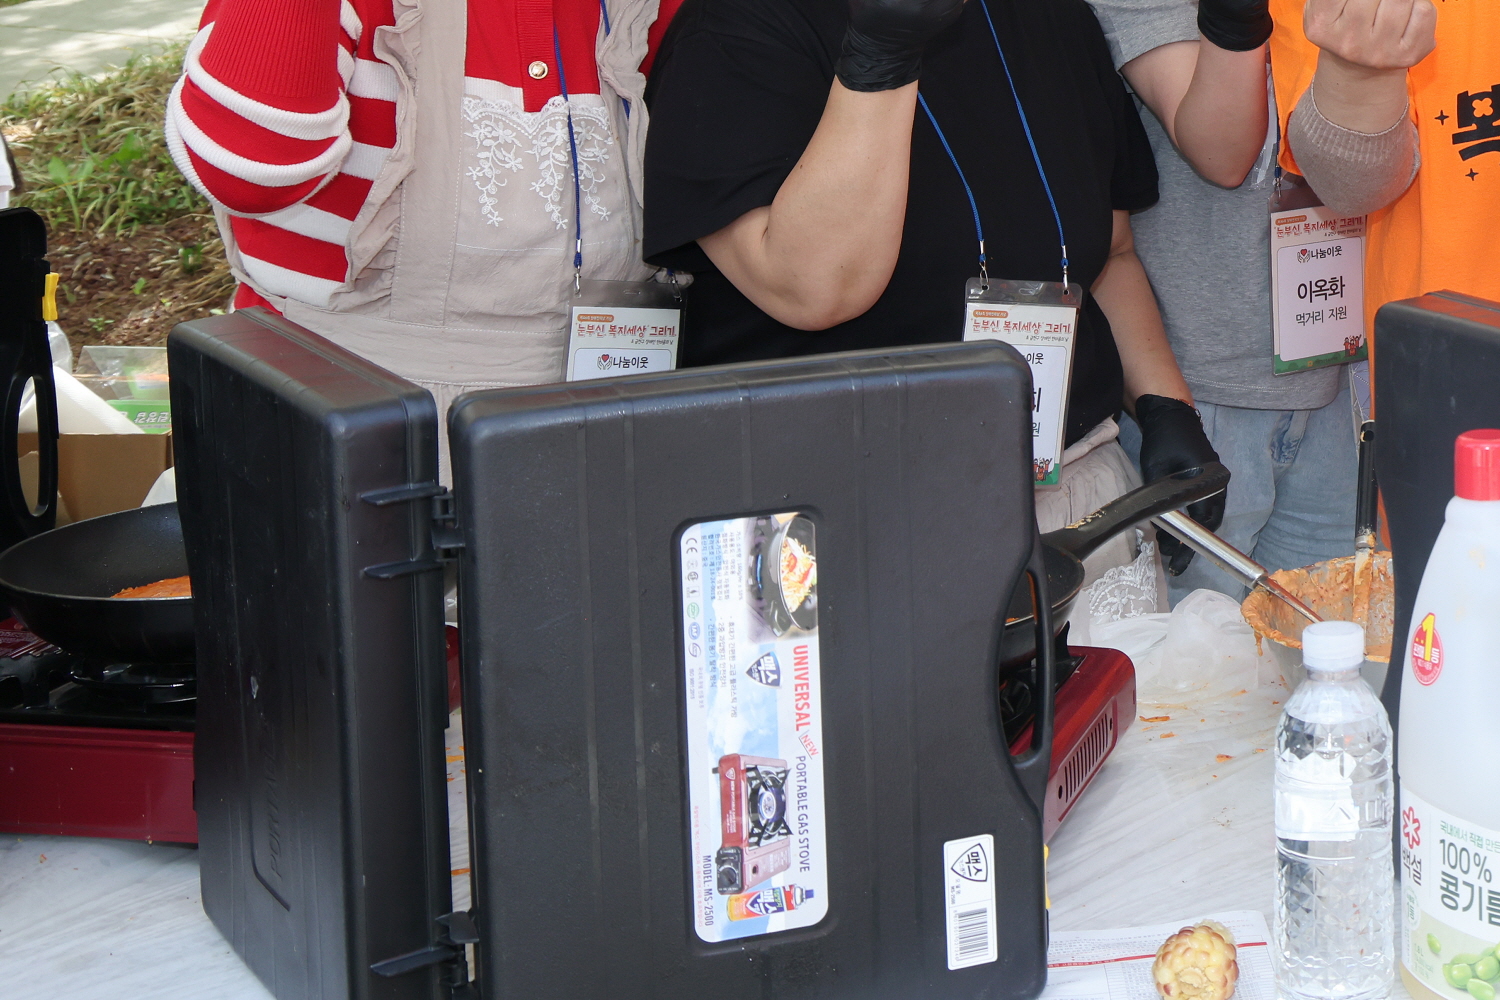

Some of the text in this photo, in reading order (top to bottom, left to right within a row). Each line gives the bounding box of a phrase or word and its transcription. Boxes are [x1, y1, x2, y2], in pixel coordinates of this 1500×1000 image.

[1311, 245, 1342, 259] 나눔이웃
[1297, 276, 1345, 303] 이옥화
[1296, 306, 1347, 326] 먹거리 지원
[613, 356, 648, 368] 나눔이웃
[758, 655, 778, 684] 맥스
[793, 644, 811, 732] UNIVERSAL
[800, 734, 819, 756] NEW
[795, 756, 810, 873] PORTABLE GAS STOVE
[1440, 820, 1468, 842] 국내에서
[1469, 832, 1484, 848] 직접
[965, 852, 983, 877] 맥스
[1439, 839, 1493, 883] 100%
[702, 855, 714, 926] MODEL: MS-2500
[758, 889, 778, 915] 맥스
